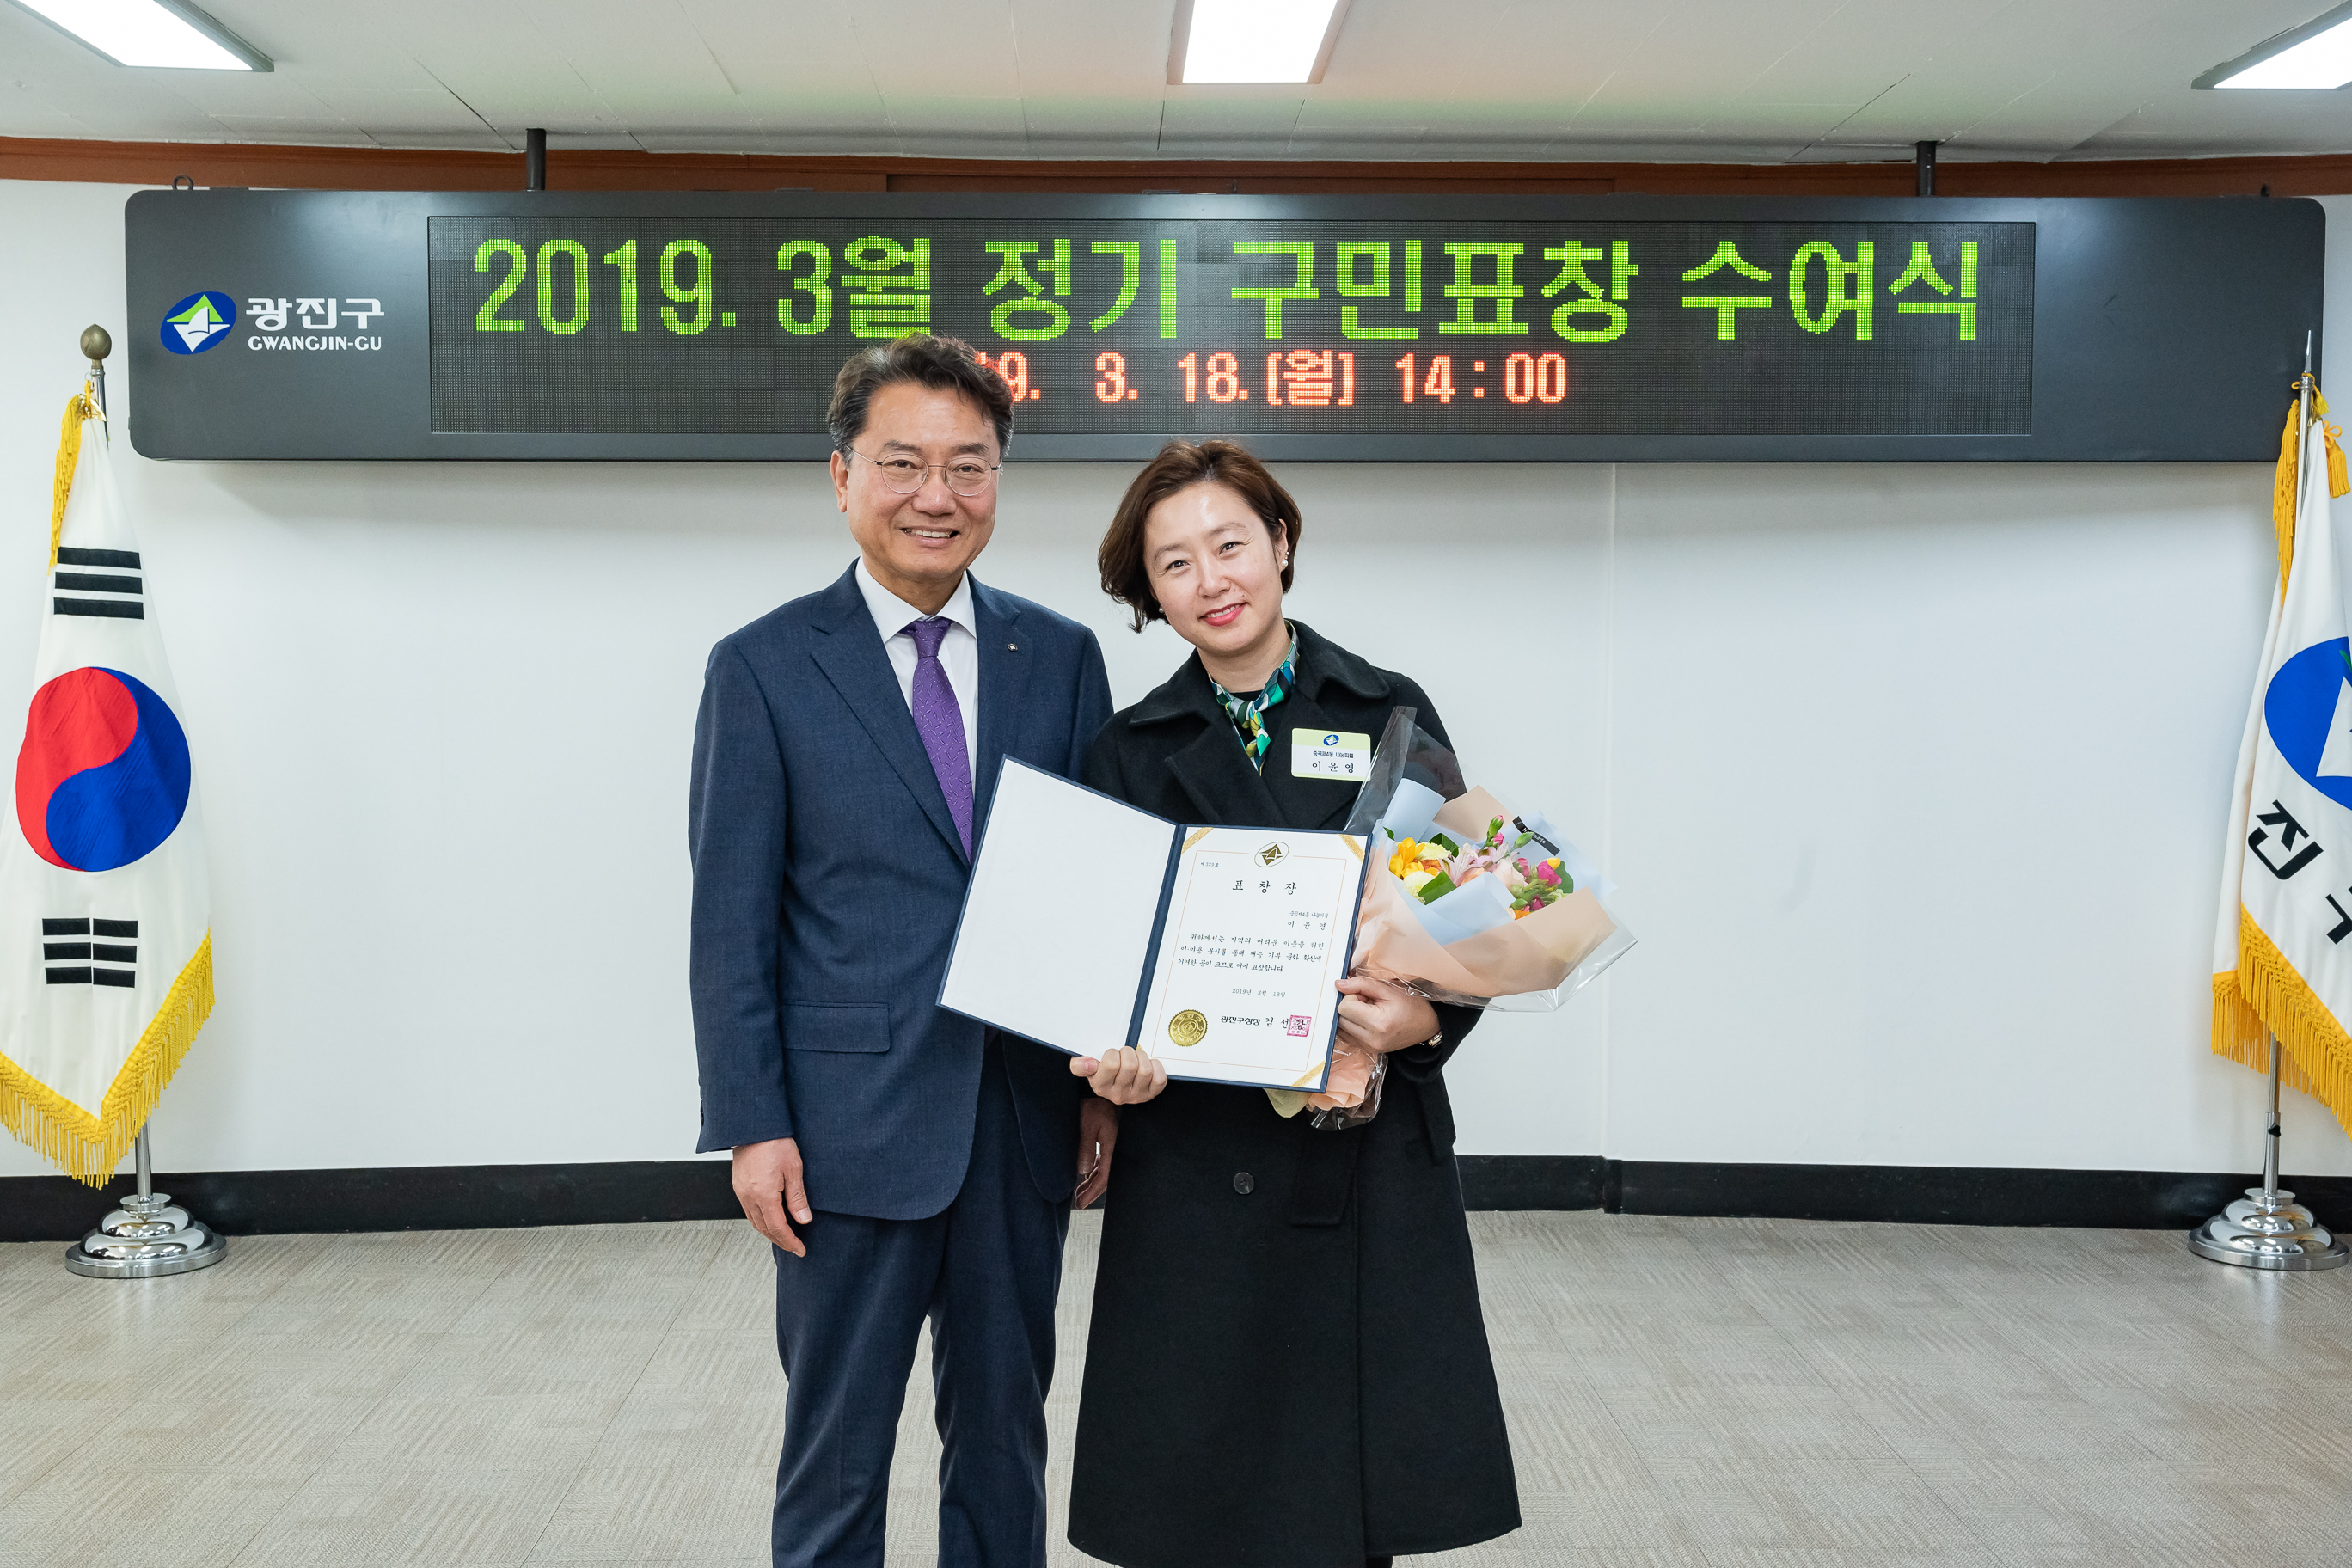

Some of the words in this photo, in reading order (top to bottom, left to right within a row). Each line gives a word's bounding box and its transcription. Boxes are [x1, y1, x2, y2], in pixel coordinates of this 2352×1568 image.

[475, 238, 736, 334] 2019.
[776, 235, 931, 339] 3월
[983, 238, 1177, 341] 정기
[1231, 239, 1638, 342] 구민표창
[1682, 241, 1977, 340] 수여식
[245, 297, 385, 332] 광진구
[247, 335, 383, 352] GWANGJIN-GU
[1095, 352, 1138, 402] 3.
[1522, 827, 1547, 844] Hmade
[1190, 933, 1225, 942] 귀하께서는
[1257, 938, 1278, 946] 어려운
[1283, 940, 1305, 948] 이웃을
[1310, 941, 1325, 950] 위한
[1178, 958, 1197, 967] 기여한
[1207, 947, 1228, 956] 봉사를
[1286, 952, 1300, 961] 문화
[1220, 1015, 1261, 1026] 광진구청장
